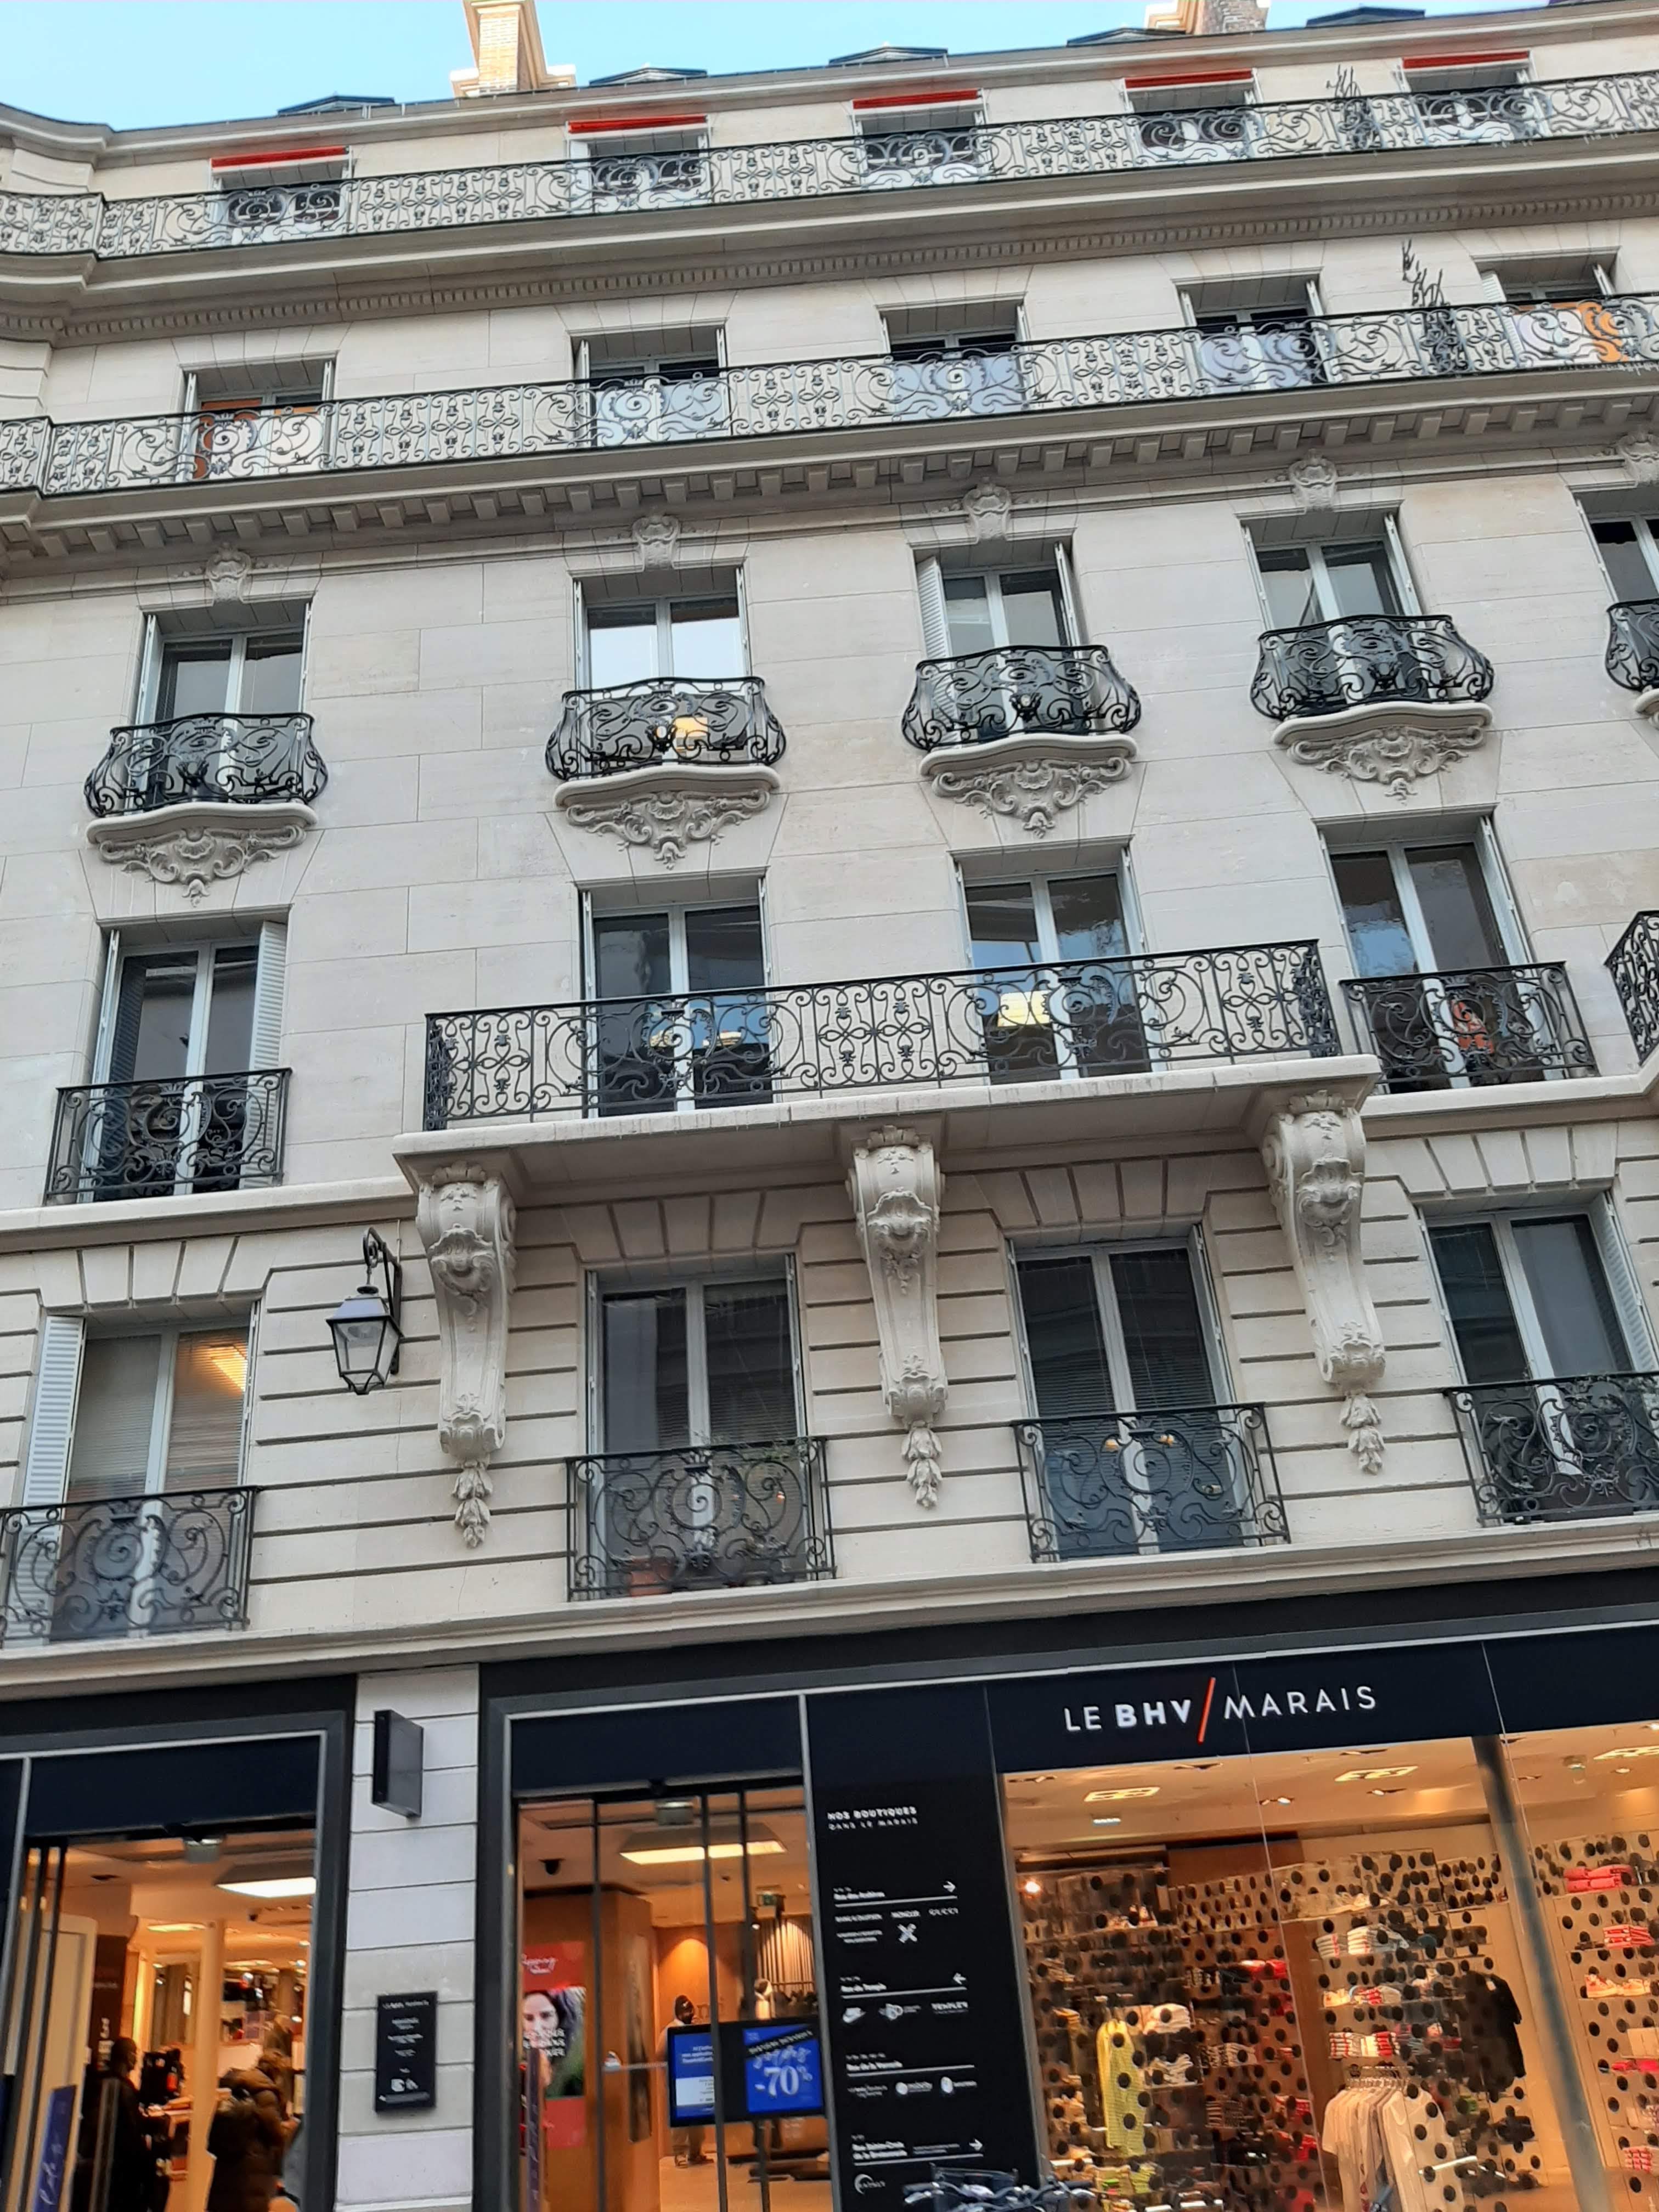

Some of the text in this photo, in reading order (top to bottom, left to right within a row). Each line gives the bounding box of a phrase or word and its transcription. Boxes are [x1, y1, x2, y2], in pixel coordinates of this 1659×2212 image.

[1064, 1706, 1102, 1731] LE
[1115, 1699, 1191, 1728] BHV
[1224, 1685, 1376, 1720] MARAIS
[827, 1806, 917, 1820] NOS BOUTIQUES
